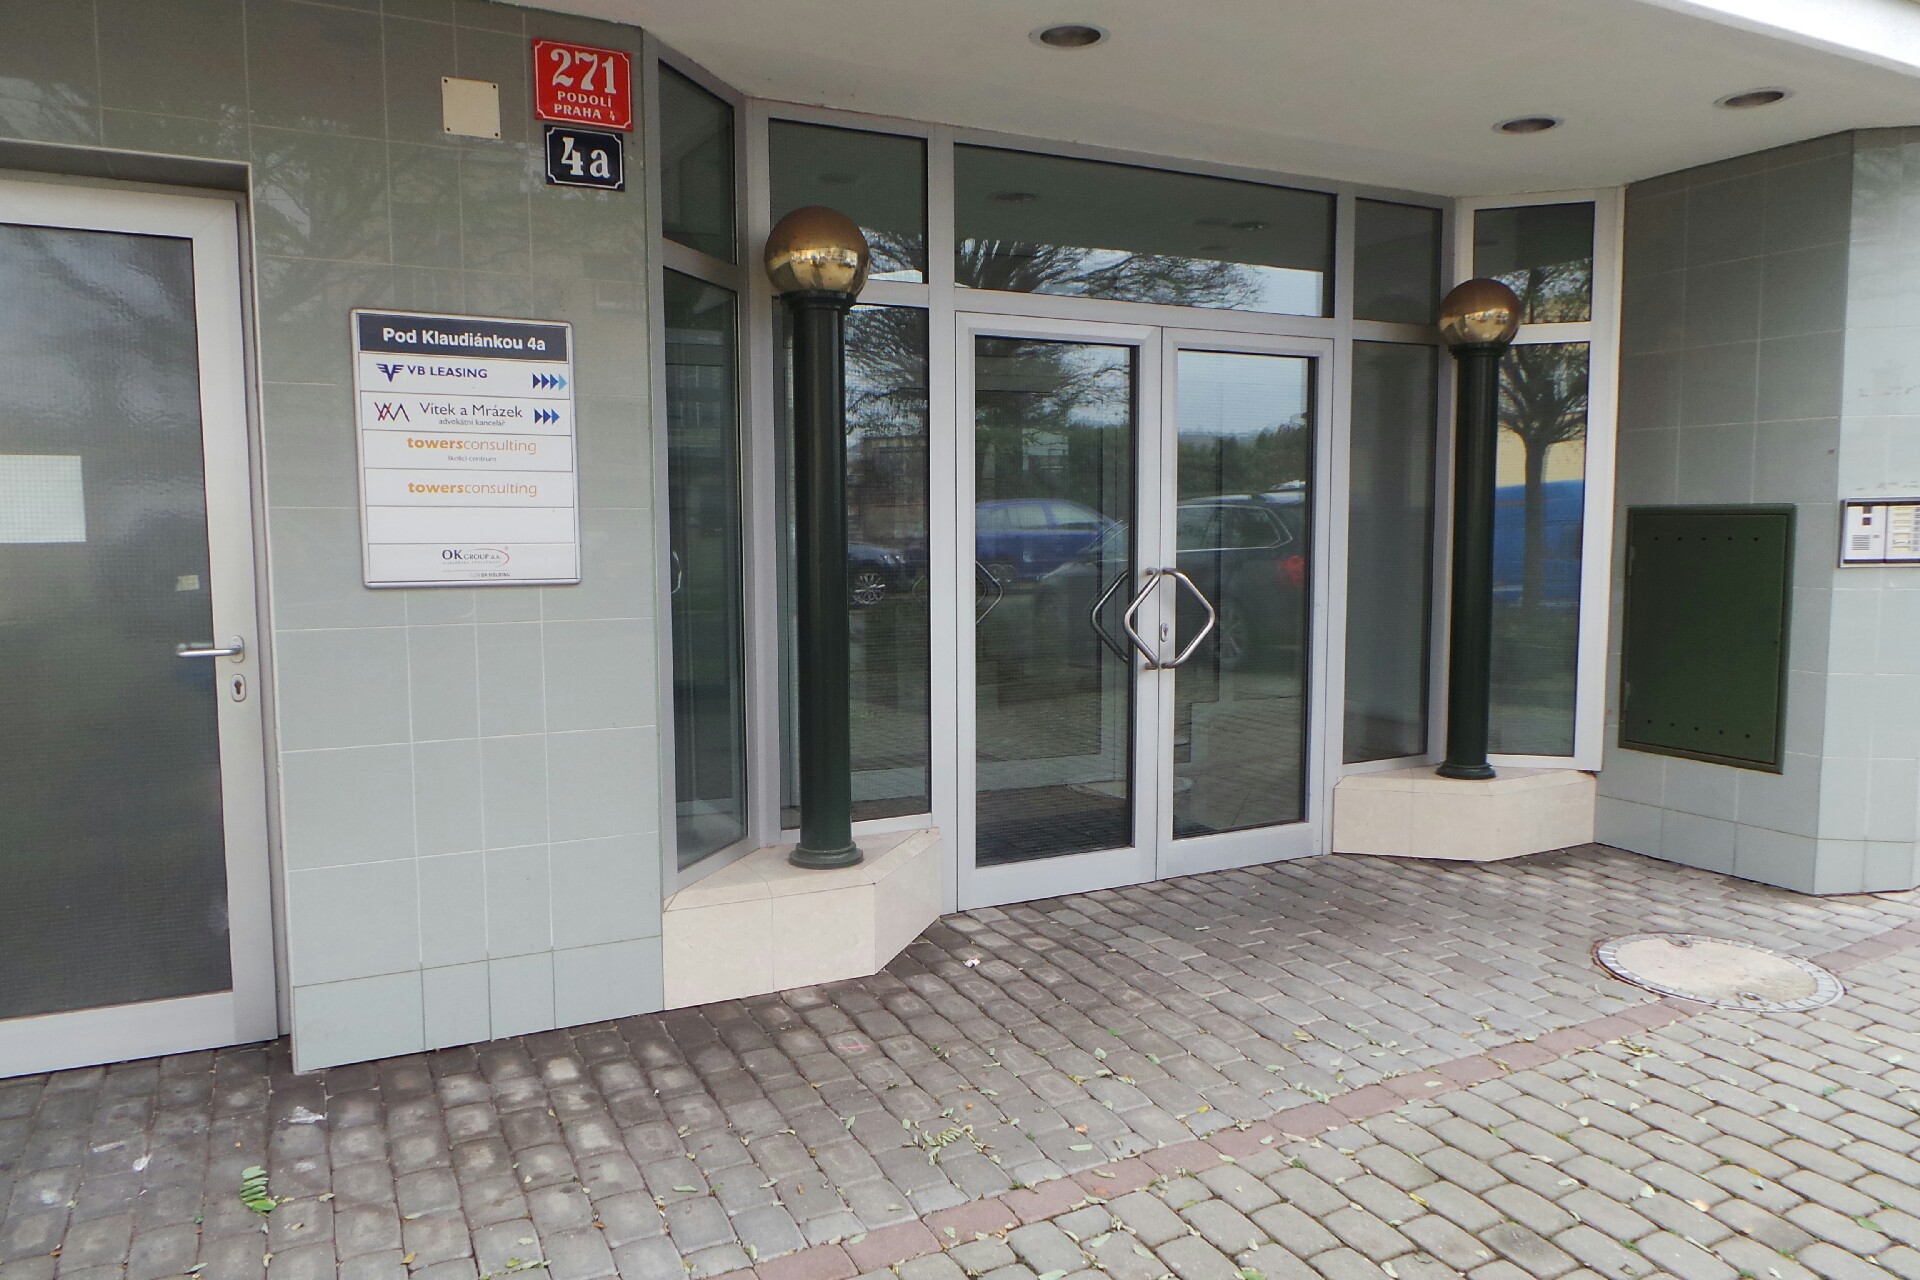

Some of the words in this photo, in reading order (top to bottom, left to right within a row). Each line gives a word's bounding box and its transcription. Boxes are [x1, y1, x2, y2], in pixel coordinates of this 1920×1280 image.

[550, 48, 617, 95] 271
[557, 90, 612, 109] PODOLÍ
[553, 103, 602, 120] PRAHA
[608, 110, 616, 122] 4
[561, 136, 611, 179] 4a
[382, 327, 418, 344] Pod
[422, 329, 524, 350] Klaudiánkou
[527, 336, 546, 351] 4a
[407, 364, 426, 376] VB
[430, 366, 488, 379] LEASING
[460, 407, 468, 416] a
[472, 404, 523, 418] Mrázek
[406, 437, 537, 455] towersconsulting
[408, 482, 537, 498] towersconsulting
